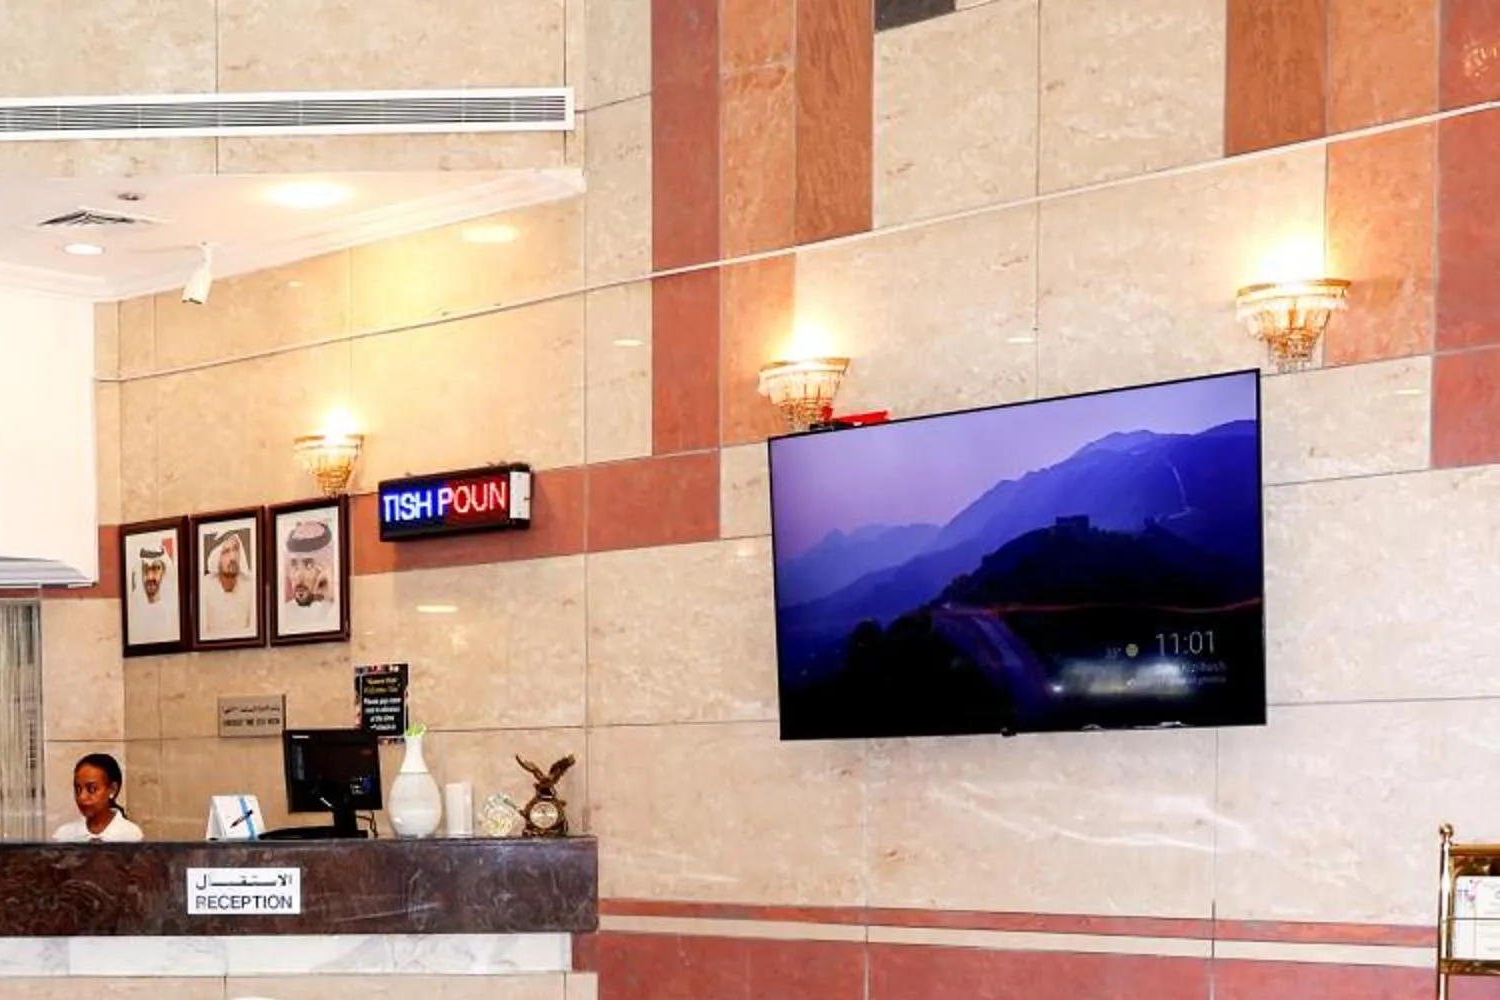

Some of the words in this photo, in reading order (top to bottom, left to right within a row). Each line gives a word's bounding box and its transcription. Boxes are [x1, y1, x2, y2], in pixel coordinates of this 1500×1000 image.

[438, 481, 507, 516] POUN
[1155, 630, 1215, 657] 11:01
[195, 895, 293, 909] RECEPTION
